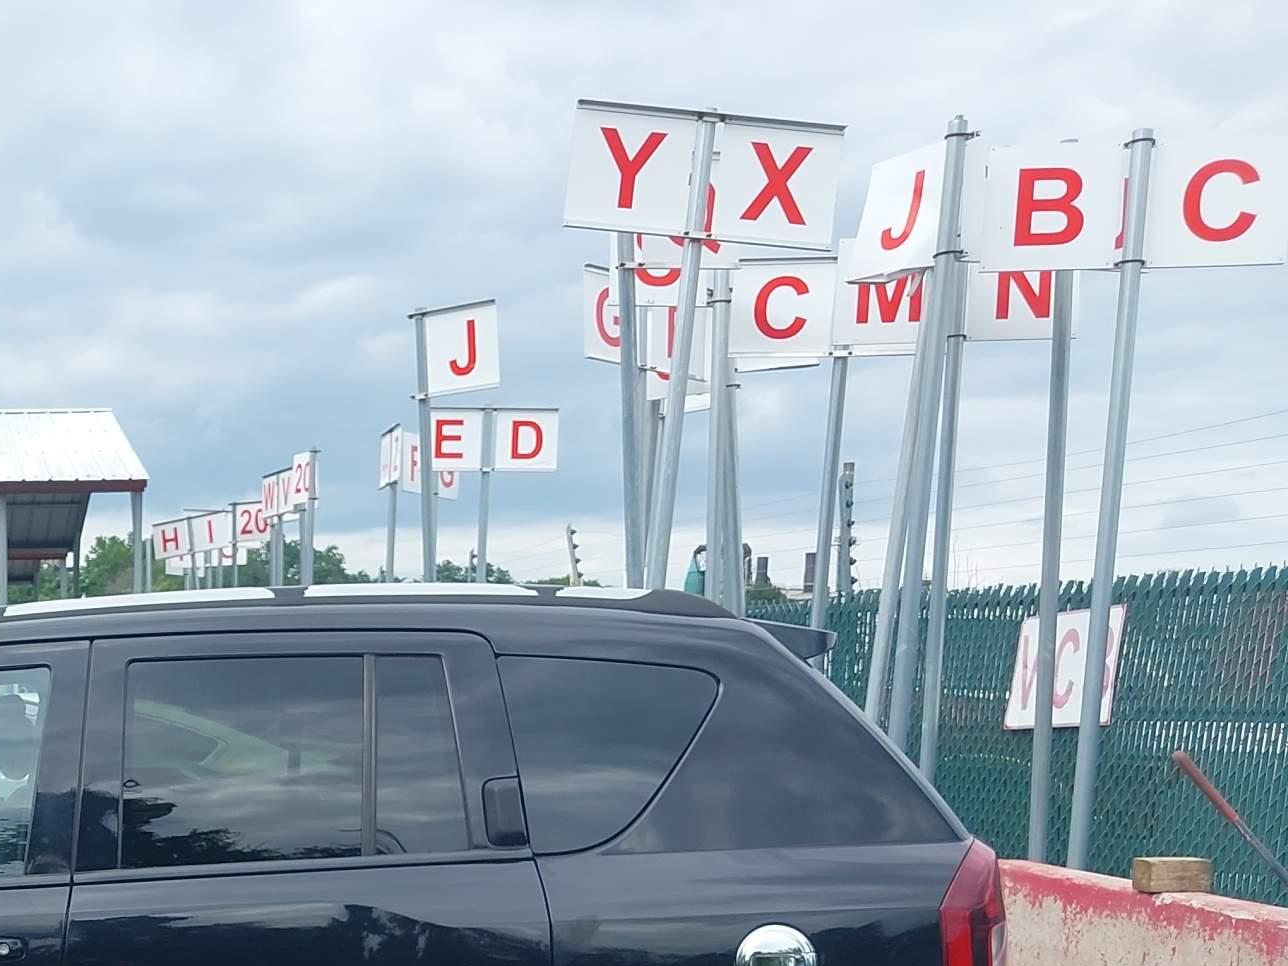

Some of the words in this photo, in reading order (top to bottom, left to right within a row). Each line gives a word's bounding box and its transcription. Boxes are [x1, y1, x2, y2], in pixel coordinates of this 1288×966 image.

[600, 126, 668, 209] Y
[740, 141, 813, 226] X
[880, 169, 926, 251] J
[1013, 166, 1085, 247] B
[1182, 158, 1261, 243] C
[753, 275, 810, 341] C
[995, 271, 1053, 321] N
[448, 319, 477, 377] J
[434, 419, 464, 459] E
[510, 420, 544, 460] D
[263, 480, 276, 510] W
[282, 476, 291, 505] V
[161, 526, 180, 553] H
[207, 519, 214, 544] I
